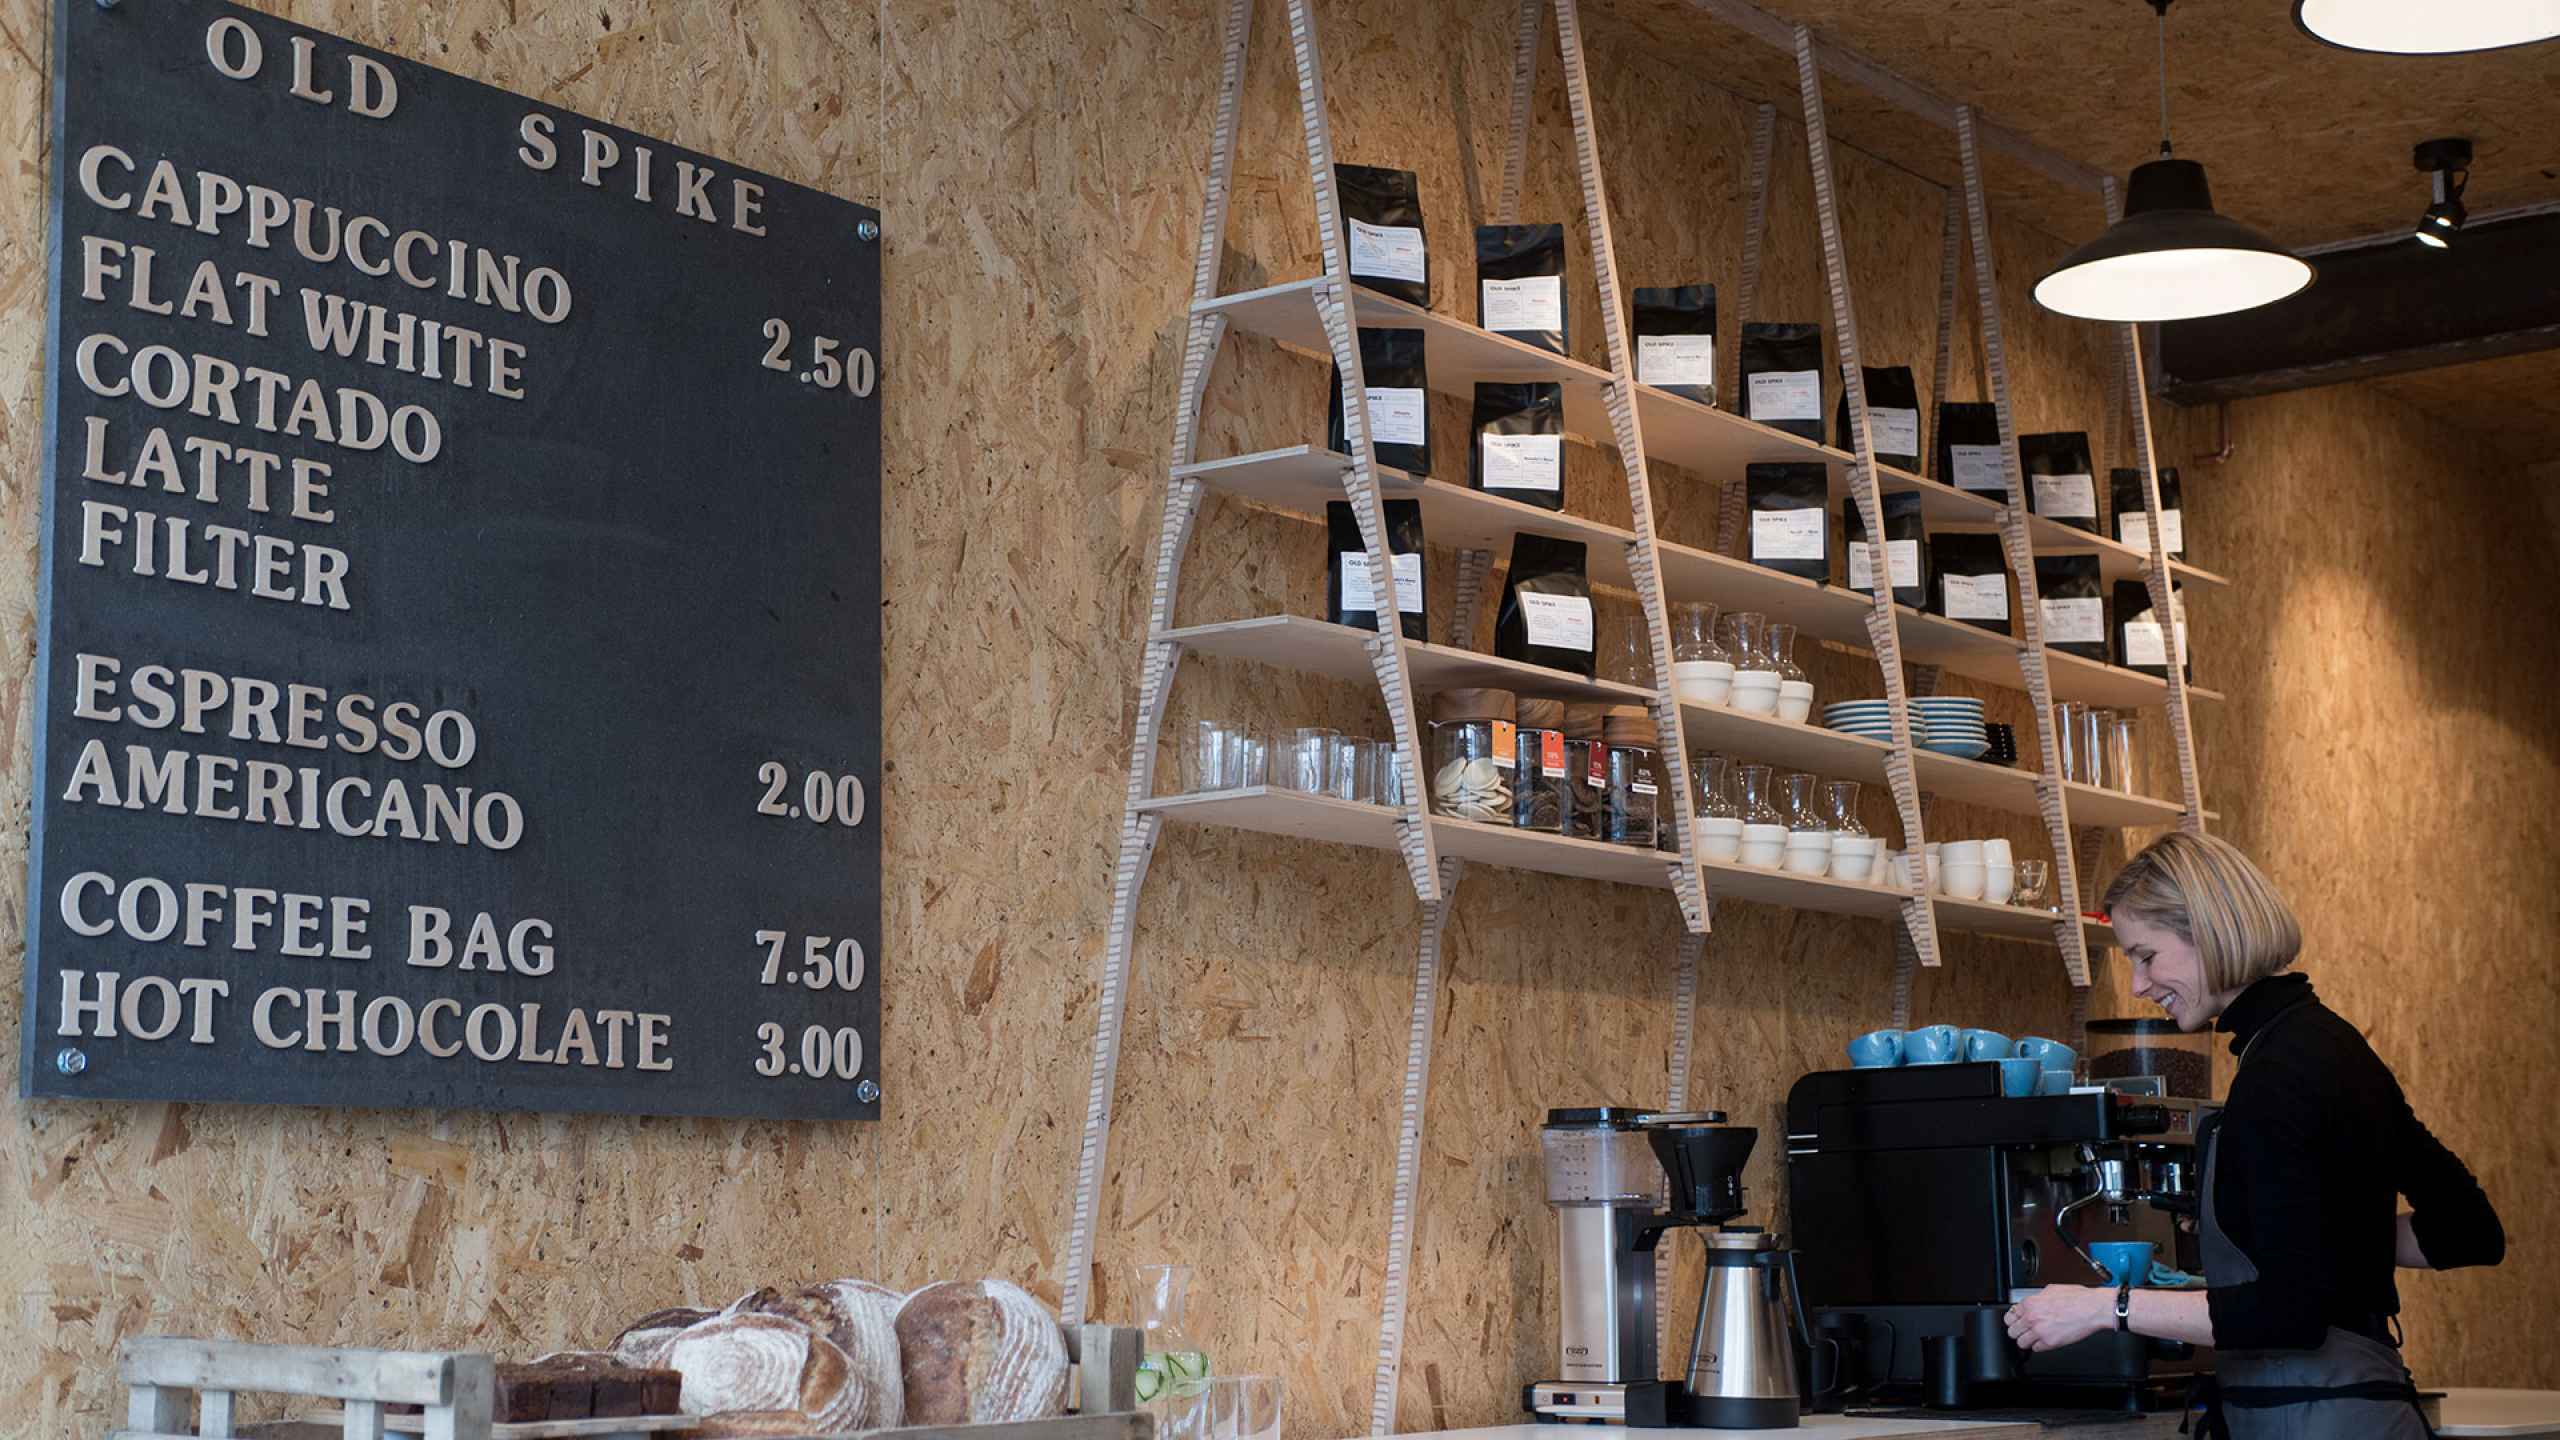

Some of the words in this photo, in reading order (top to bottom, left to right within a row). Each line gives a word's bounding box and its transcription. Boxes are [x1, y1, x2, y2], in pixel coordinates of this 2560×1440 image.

[205, 17, 398, 118] OLD
[518, 113, 766, 236] SPIKE
[79, 145, 572, 323] CAPPUCCINO
[761, 318, 875, 397] 2.50
[81, 235, 281, 337] FLAT
[299, 287, 526, 400] WHITE
[75, 333, 441, 463] CORTADO
[81, 415, 335, 523] LATTE
[78, 500, 351, 610] FILTER
[62, 739, 524, 850] AMERICANO
[72, 652, 476, 768] ESPRESSO
[757, 761, 865, 826] 2.00
[60, 871, 372, 959] COFFEE
[406, 904, 554, 976] BAG
[754, 929, 865, 991] 7.50
[56, 968, 230, 1044] HOT
[252, 986, 673, 1071] CHOCOLATE
[755, 1022, 863, 1080] 3.00
